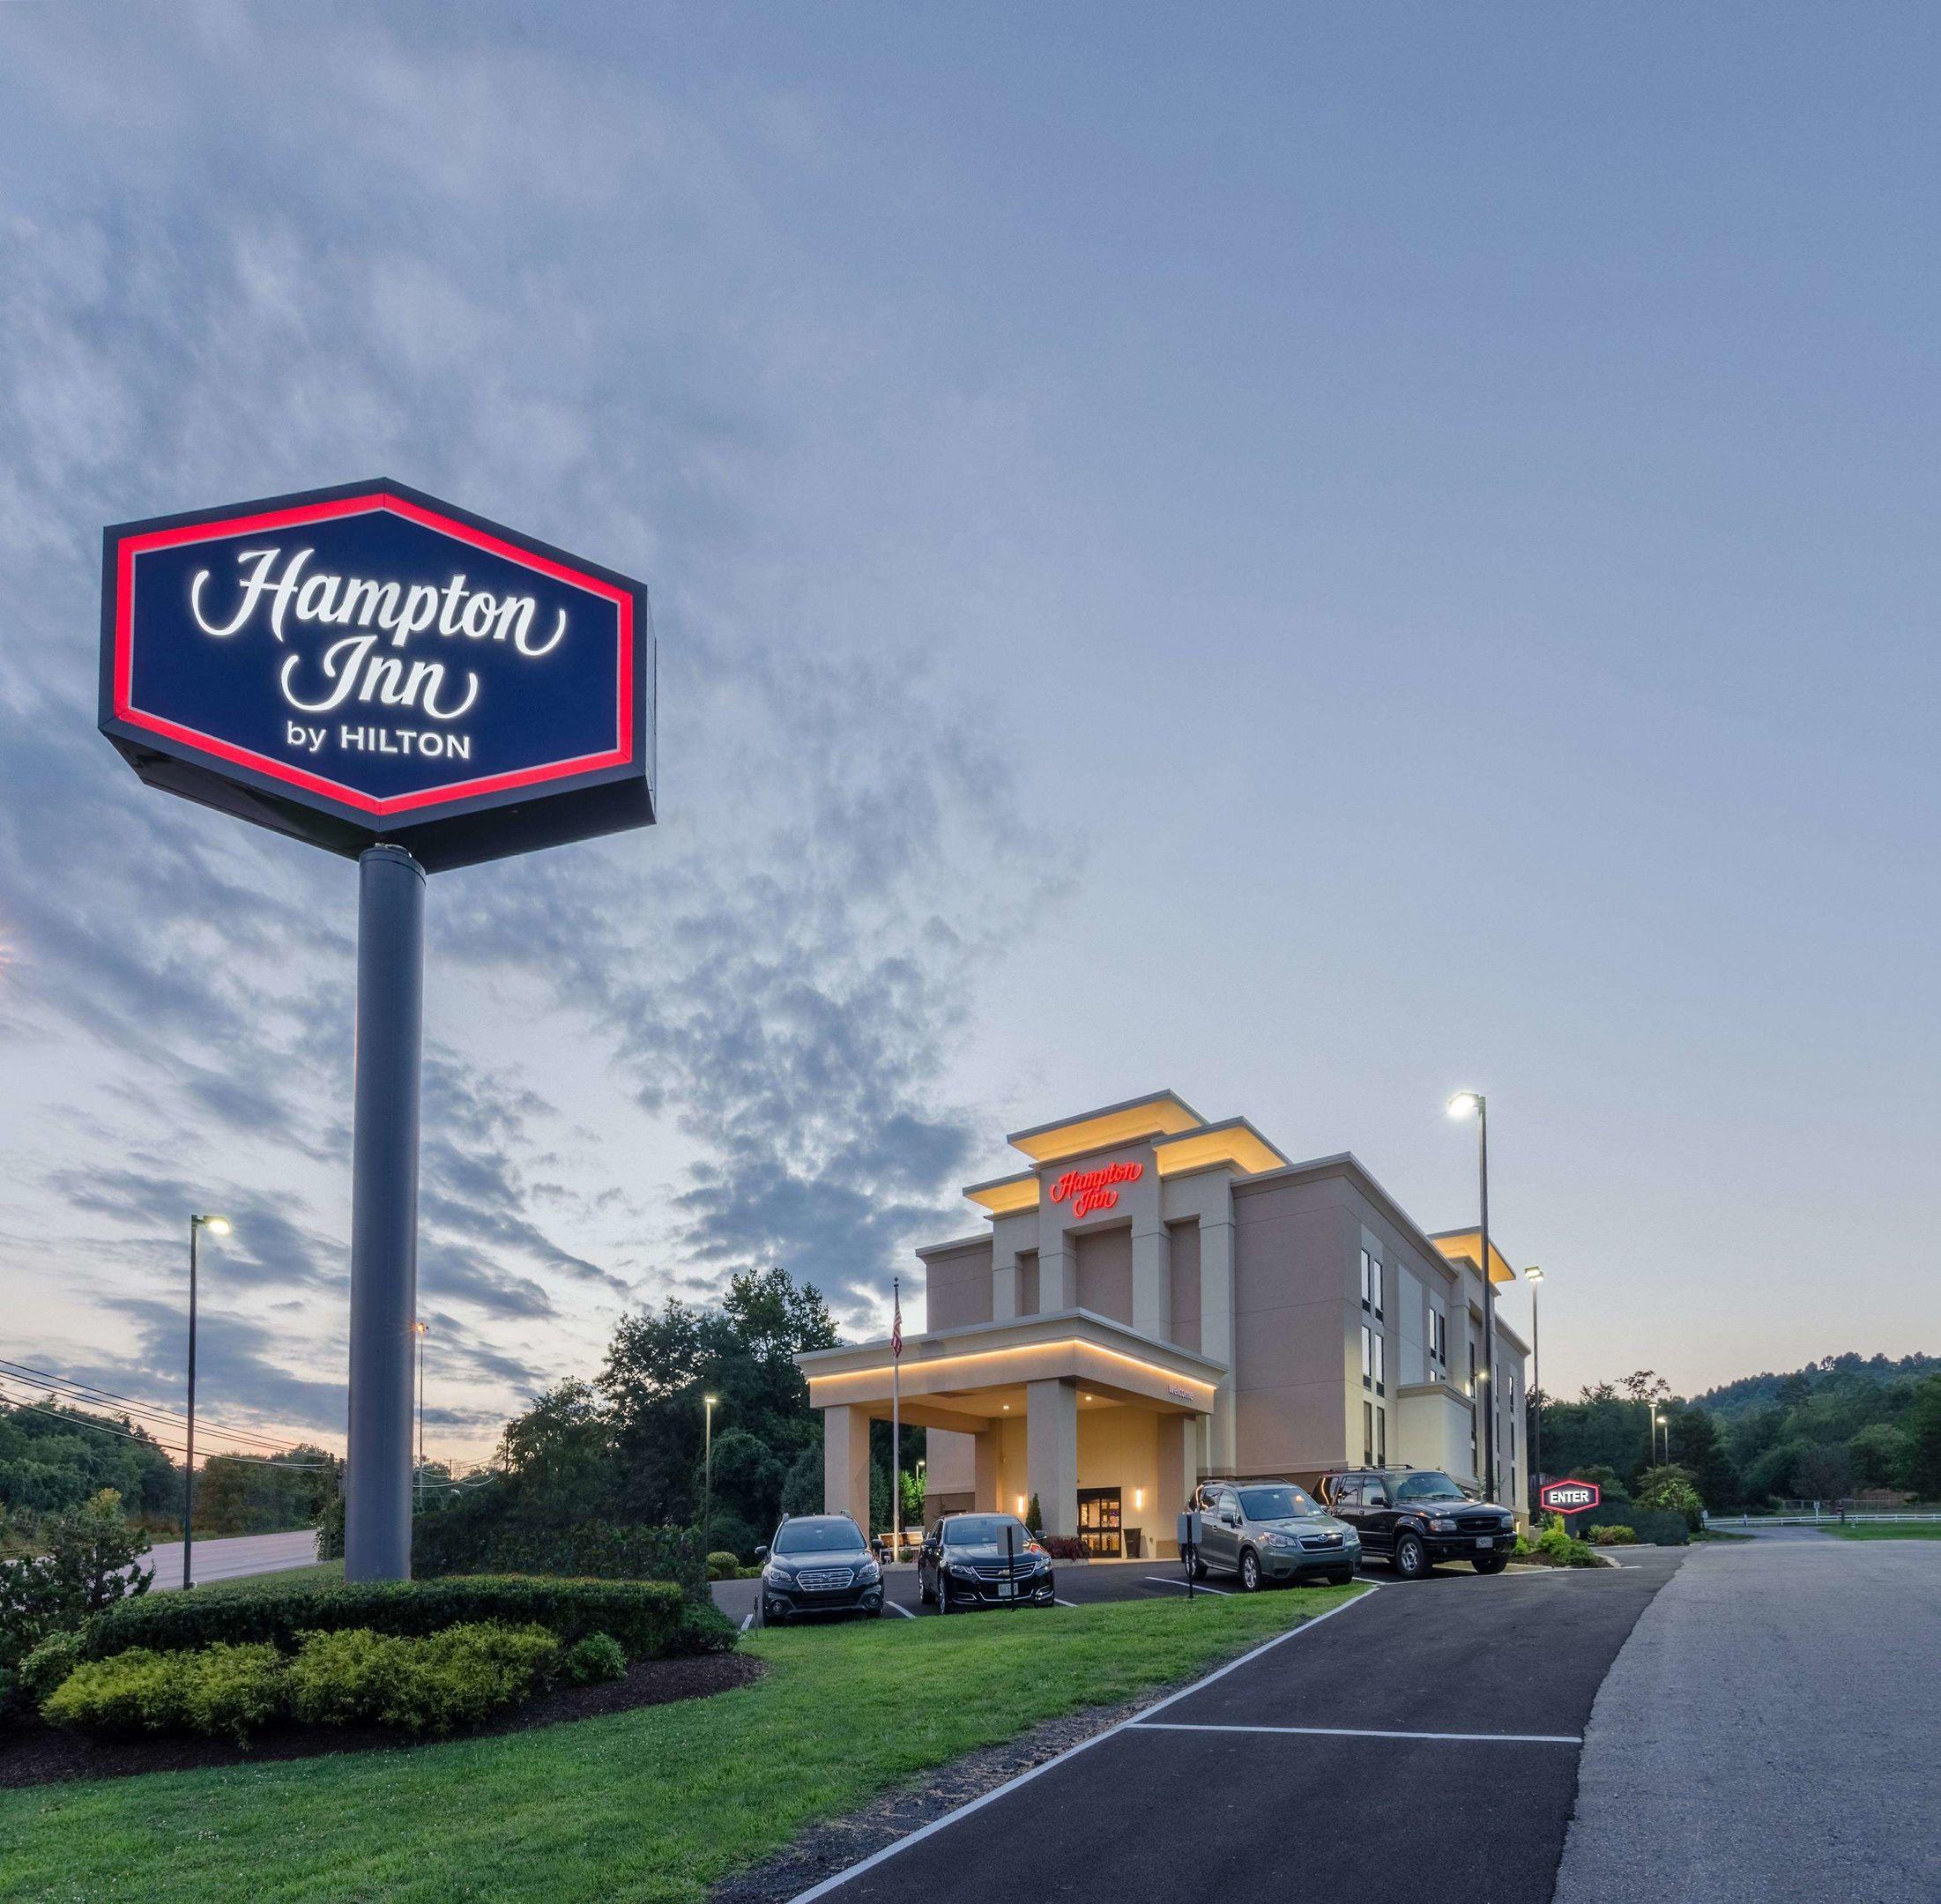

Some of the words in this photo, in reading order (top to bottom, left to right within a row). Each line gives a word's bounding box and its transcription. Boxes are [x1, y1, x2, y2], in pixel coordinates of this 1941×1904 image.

[191, 548, 567, 657] Hampton
[280, 635, 479, 720] Inn
[287, 720, 327, 752] by
[341, 725, 470, 759] HILTON
[1050, 1162, 1142, 1204] Hampton
[1073, 1189, 1119, 1219] Inn
[1550, 1491, 1589, 1504] ENTER
